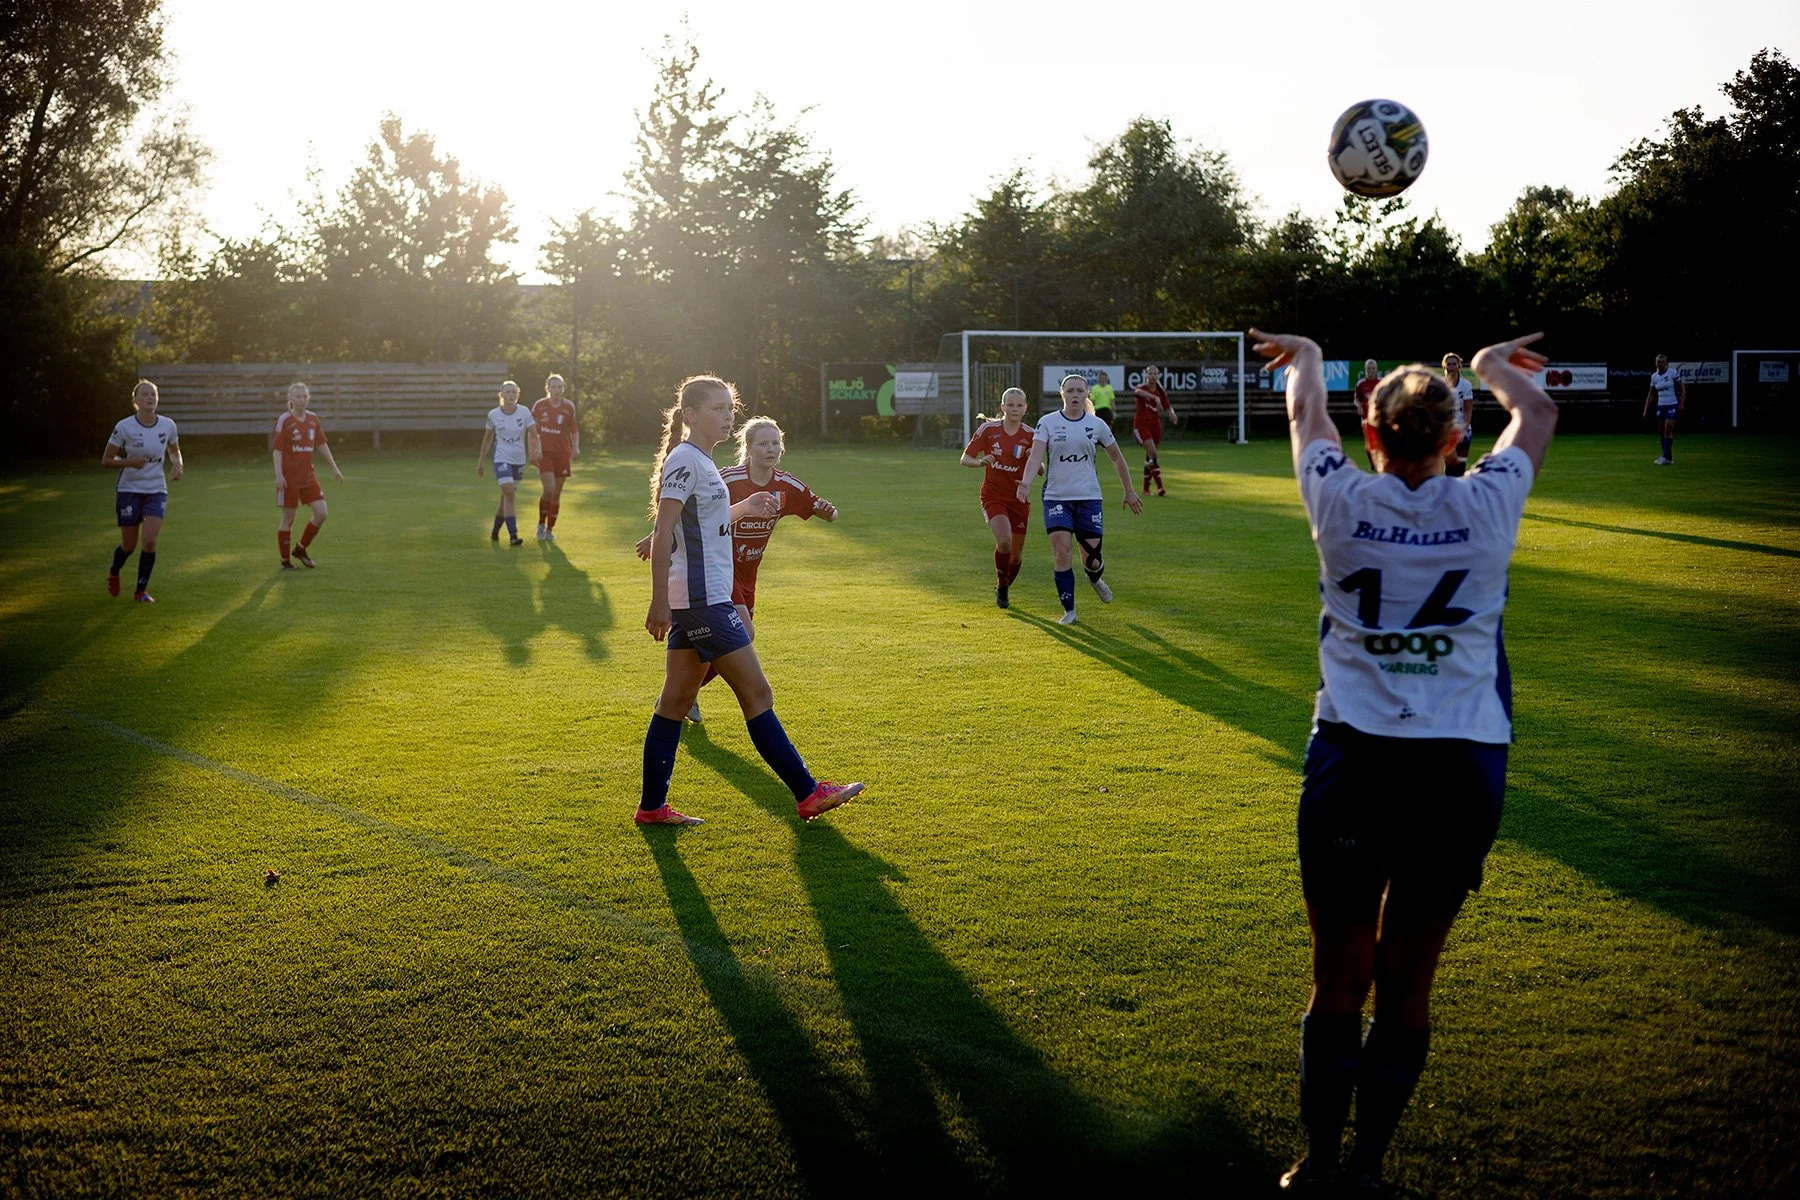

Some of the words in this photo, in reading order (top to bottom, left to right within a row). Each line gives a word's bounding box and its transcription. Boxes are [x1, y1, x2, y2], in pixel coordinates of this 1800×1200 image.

[1358, 126, 1395, 176] SELECT
[829, 390, 877, 400] SCHAKT
[740, 521, 767, 530] CIRCLE
[687, 627, 711, 637] arvato
[1364, 632, 1454, 662] coop
